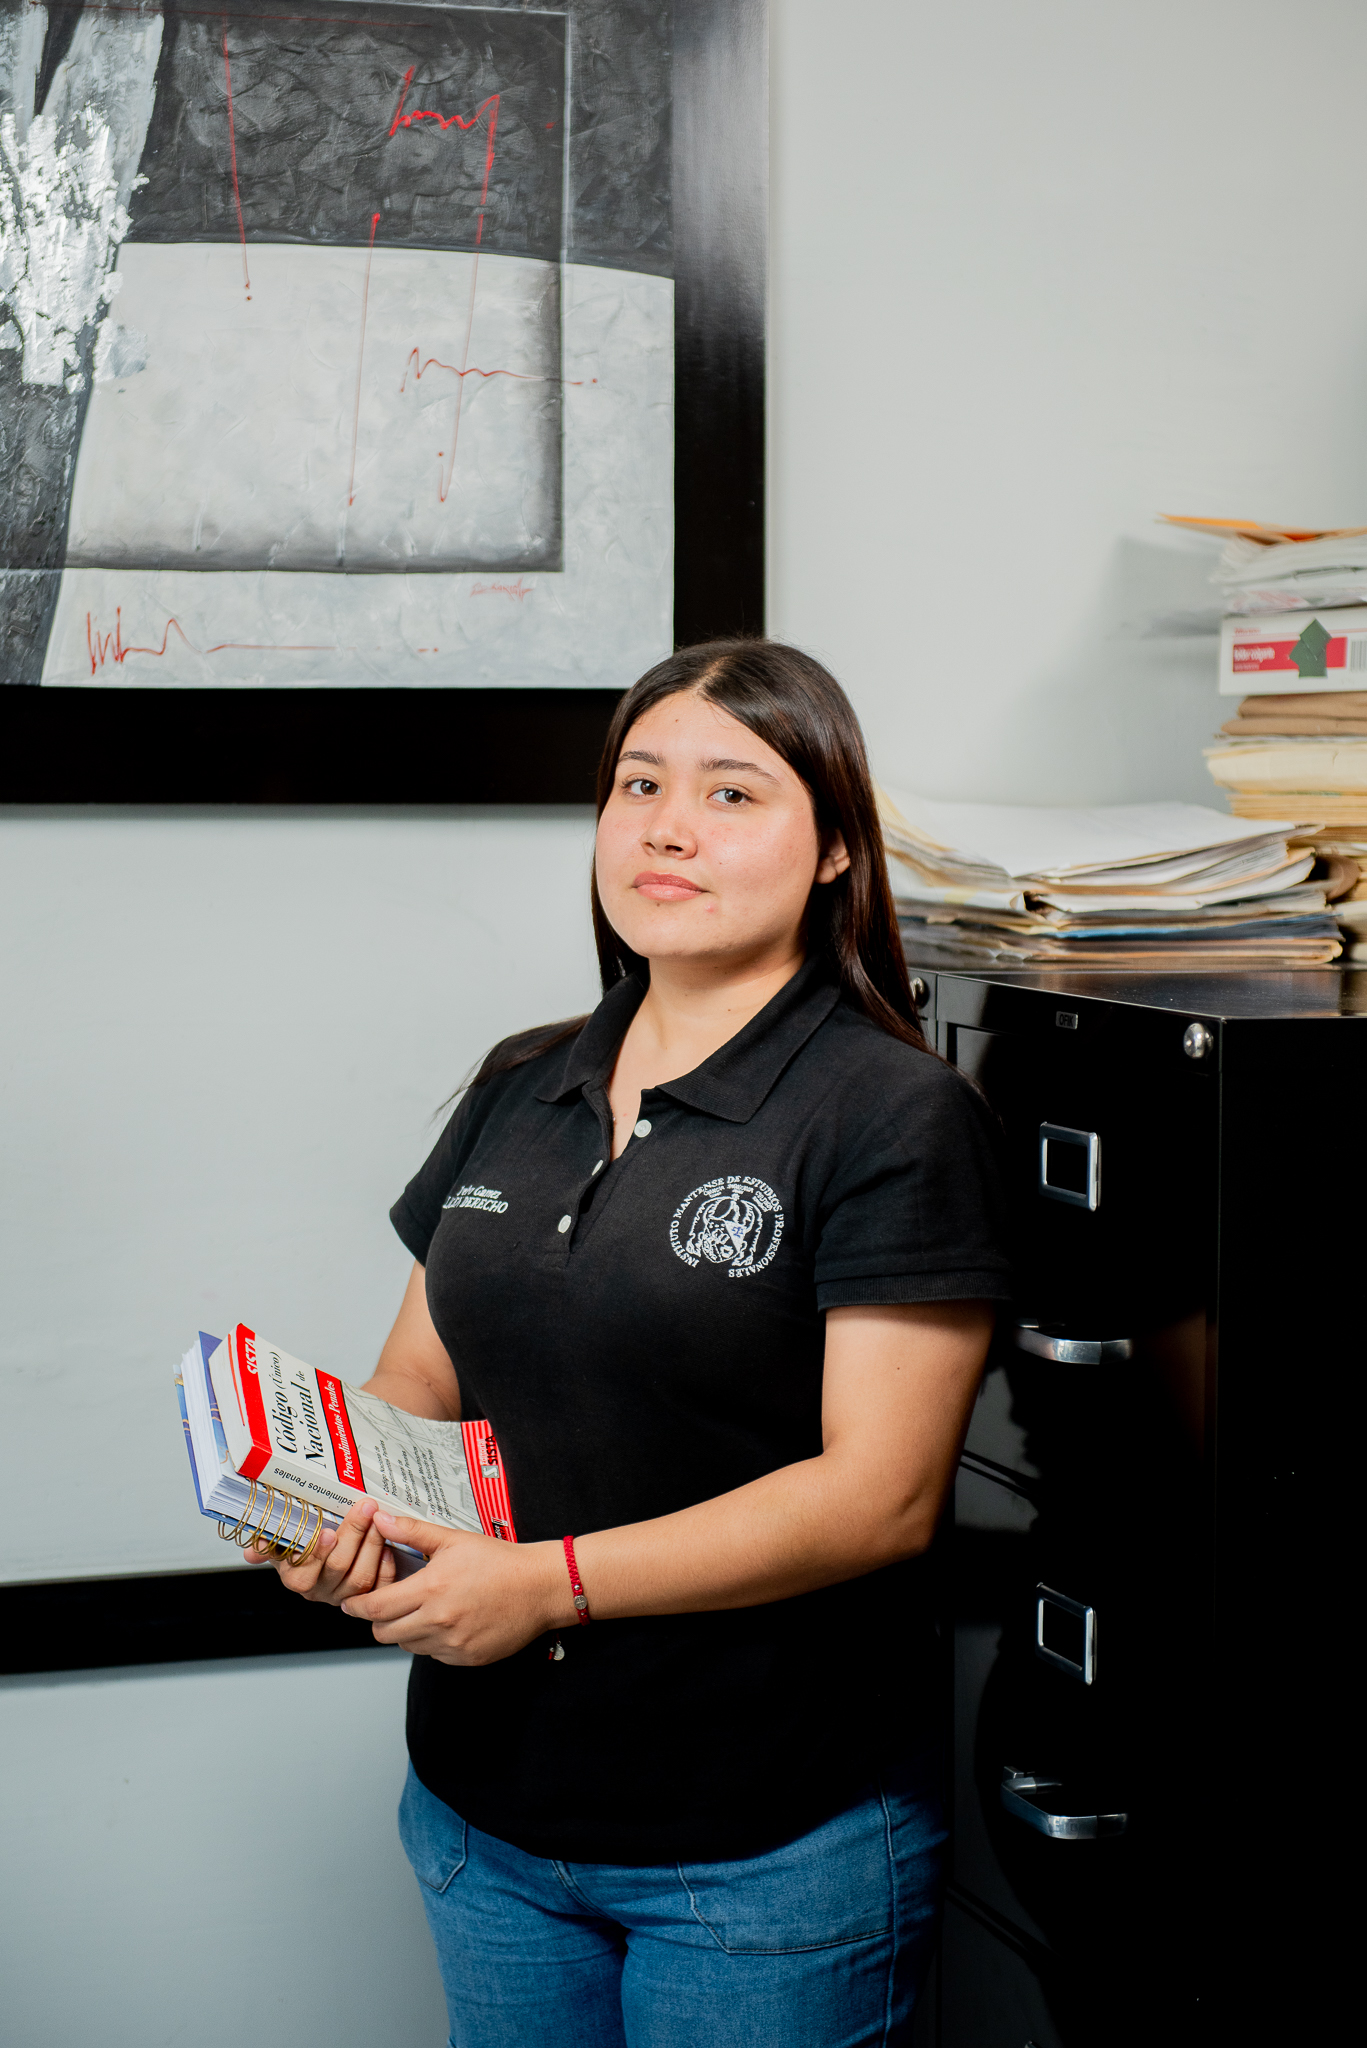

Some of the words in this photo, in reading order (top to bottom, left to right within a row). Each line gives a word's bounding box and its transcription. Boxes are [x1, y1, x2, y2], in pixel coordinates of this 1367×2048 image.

[460, 1196, 509, 1214] DERECHO
[672, 1177, 725, 1219] MANTENSE
[726, 1175, 742, 1184] DE
[742, 1176, 783, 1212] ESTUDIOS
[244, 1337, 259, 1375] SISTA
[268, 1351, 287, 1390] (Único)
[296, 1370, 306, 1382] de
[324, 1380, 341, 1414] Penales
[271, 1391, 299, 1454] Código
[290, 1380, 327, 1469] Nacional
[334, 1414, 356, 1481] Procedimientos
[484, 1435, 499, 1465] SISTA
[273, 1467, 307, 1487] Penales
[307, 1482, 356, 1507] edimientos
